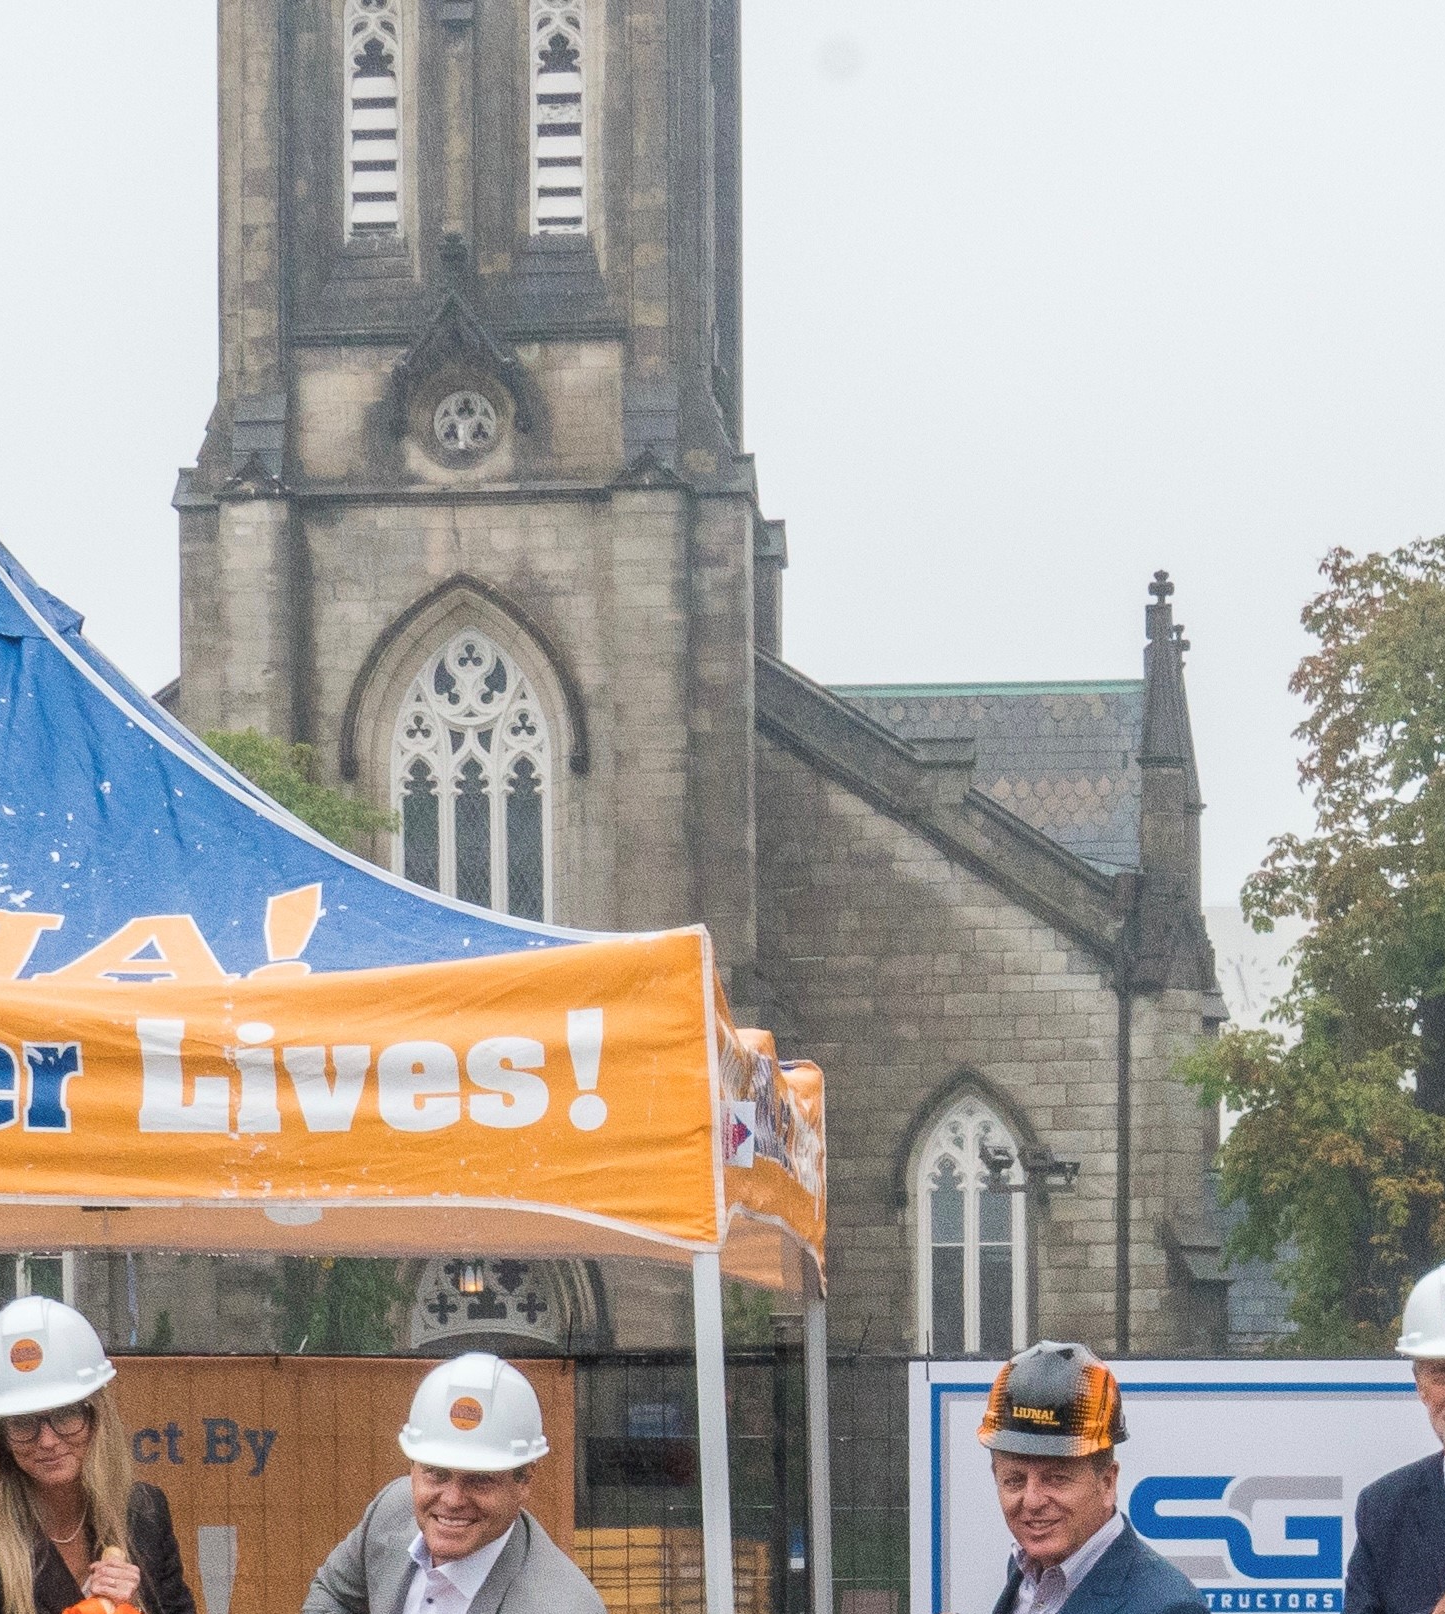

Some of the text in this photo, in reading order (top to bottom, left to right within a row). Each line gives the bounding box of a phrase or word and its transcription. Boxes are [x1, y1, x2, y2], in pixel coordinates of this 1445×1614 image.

[136, 1008, 609, 1133] Lives!
[1012, 1406, 1055, 1420] LiUNA!
[203, 1418, 278, 1477] By
[1129, 1476, 1343, 1579] SG
[1205, 1592, 1335, 1610] TRUCTORS
